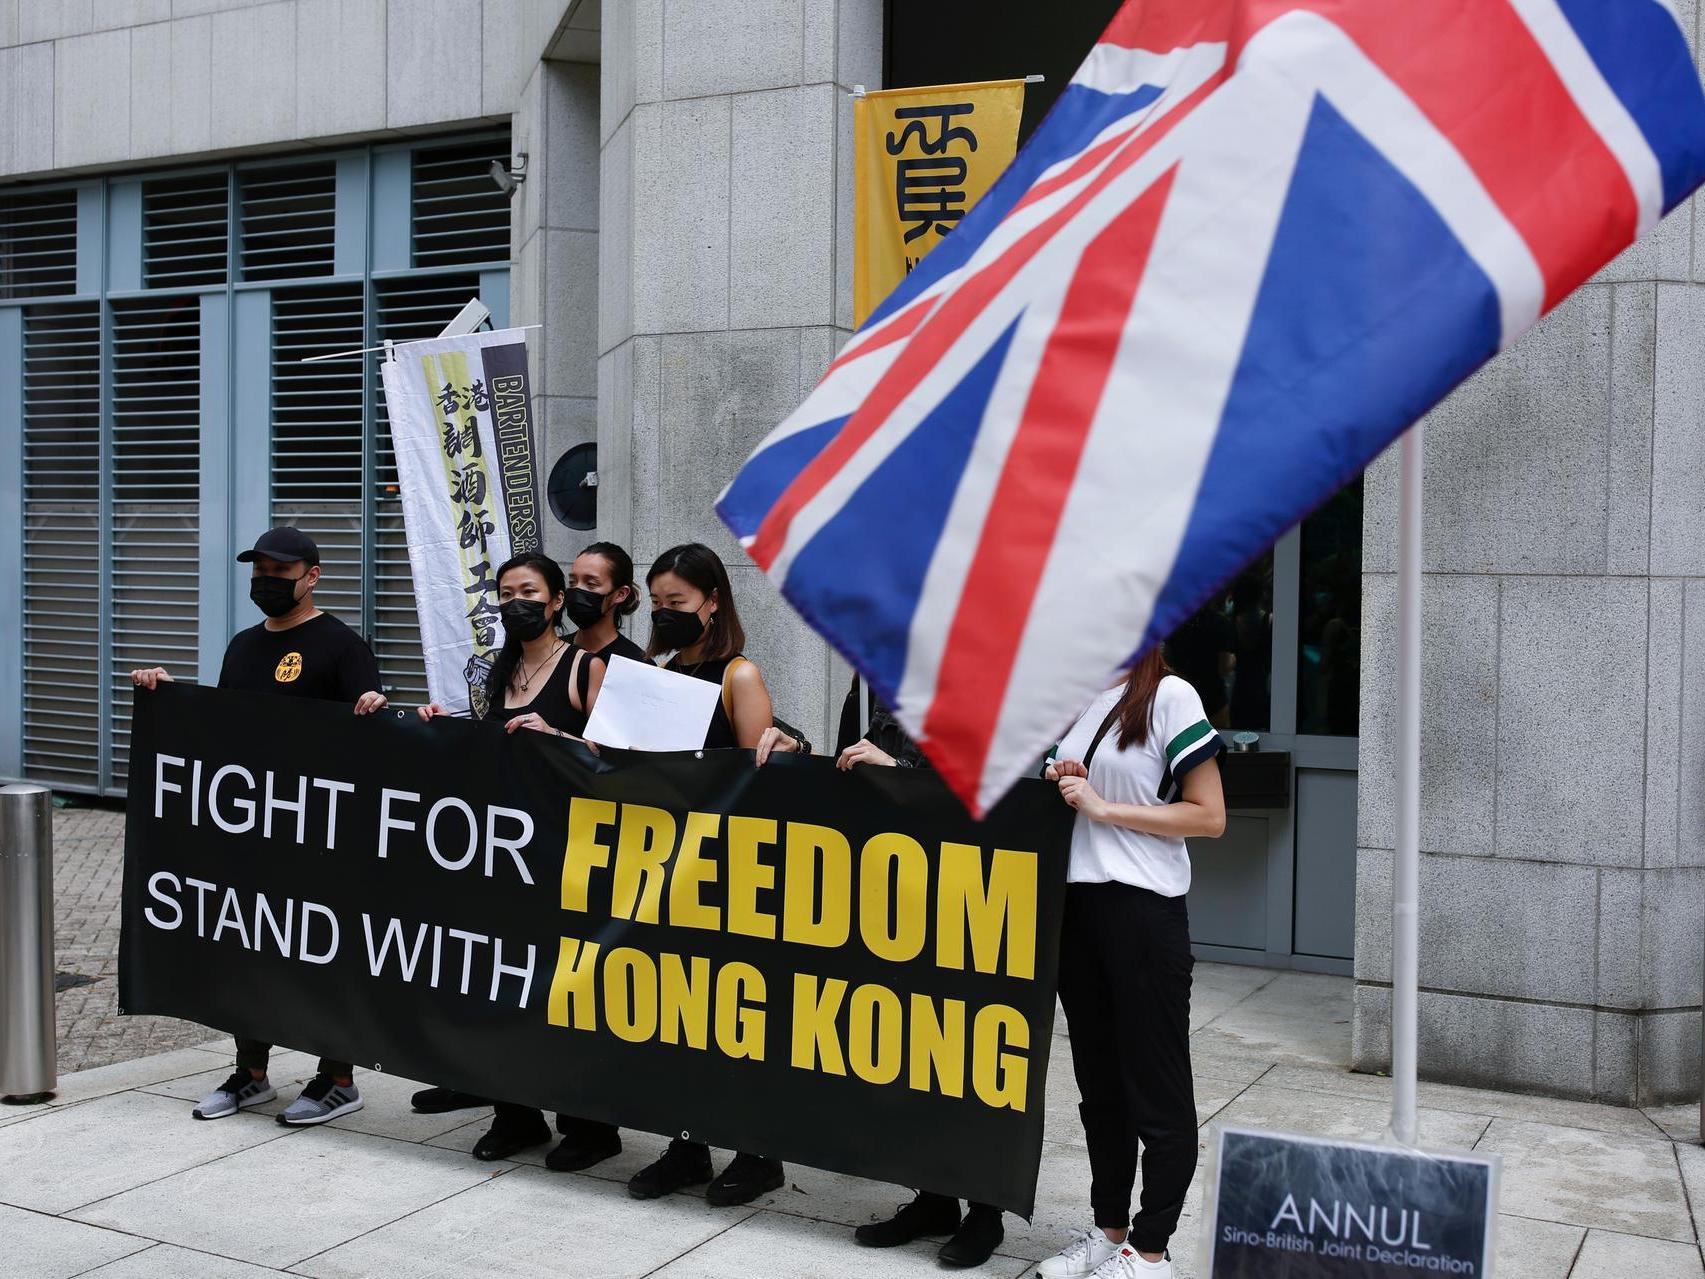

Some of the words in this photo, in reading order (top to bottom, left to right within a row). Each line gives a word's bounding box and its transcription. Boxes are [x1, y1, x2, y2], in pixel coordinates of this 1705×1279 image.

[436, 379, 490, 414] 香港
[492, 375, 537, 538] BARTENDERS
[443, 416, 500, 647] 調酒師工會
[154, 753, 355, 850] FIGHT
[378, 787, 535, 885] FOR
[561, 797, 1038, 980] FREEDOM
[144, 871, 340, 965] STAND
[361, 913, 537, 1009] WITH
[547, 936, 767, 1062] HONG
[790, 972, 1030, 1113] KONG
[1222, 1224, 1315, 1255] Sino-British
[1319, 1238, 1362, 1261] Joint
[1366, 1245, 1475, 1276] Declaration
[1271, 1193, 1431, 1250] ANNUL
